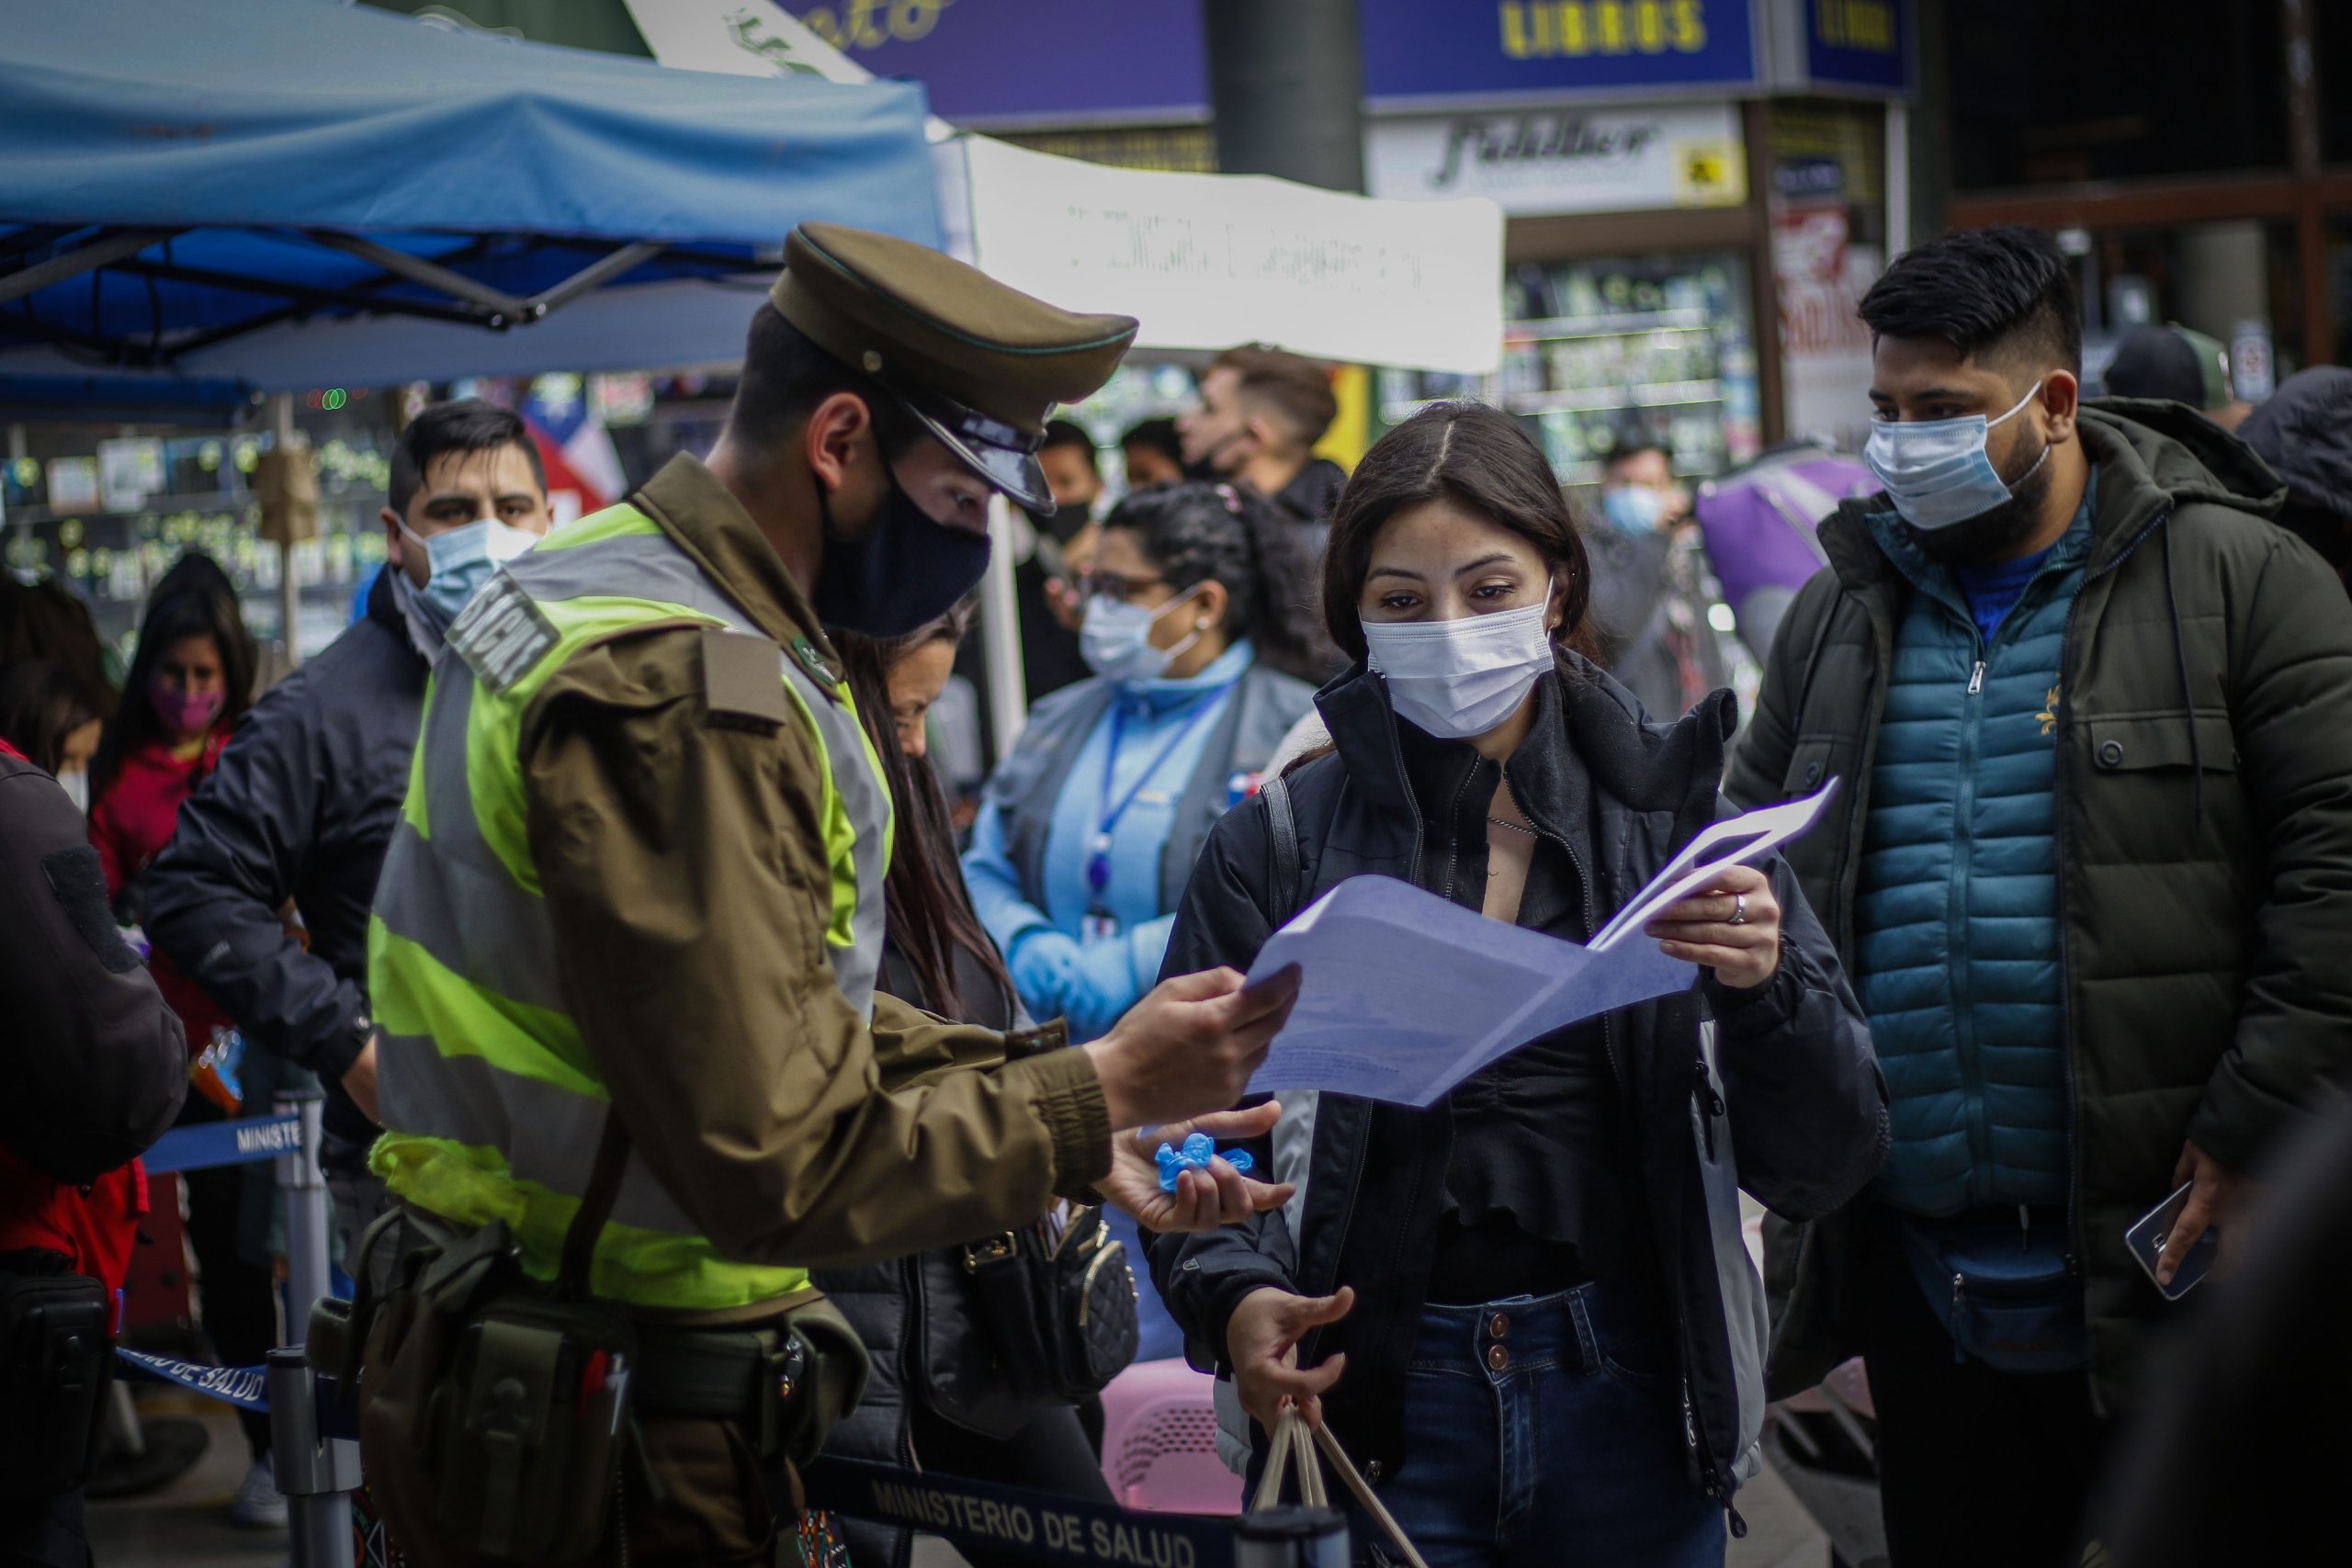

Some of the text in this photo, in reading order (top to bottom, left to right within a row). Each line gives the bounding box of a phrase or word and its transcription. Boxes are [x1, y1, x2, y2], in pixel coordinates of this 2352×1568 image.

[198, 1367, 265, 1402] SALUD
[872, 1479, 1196, 1568] MINISTERIO DE SALUD
